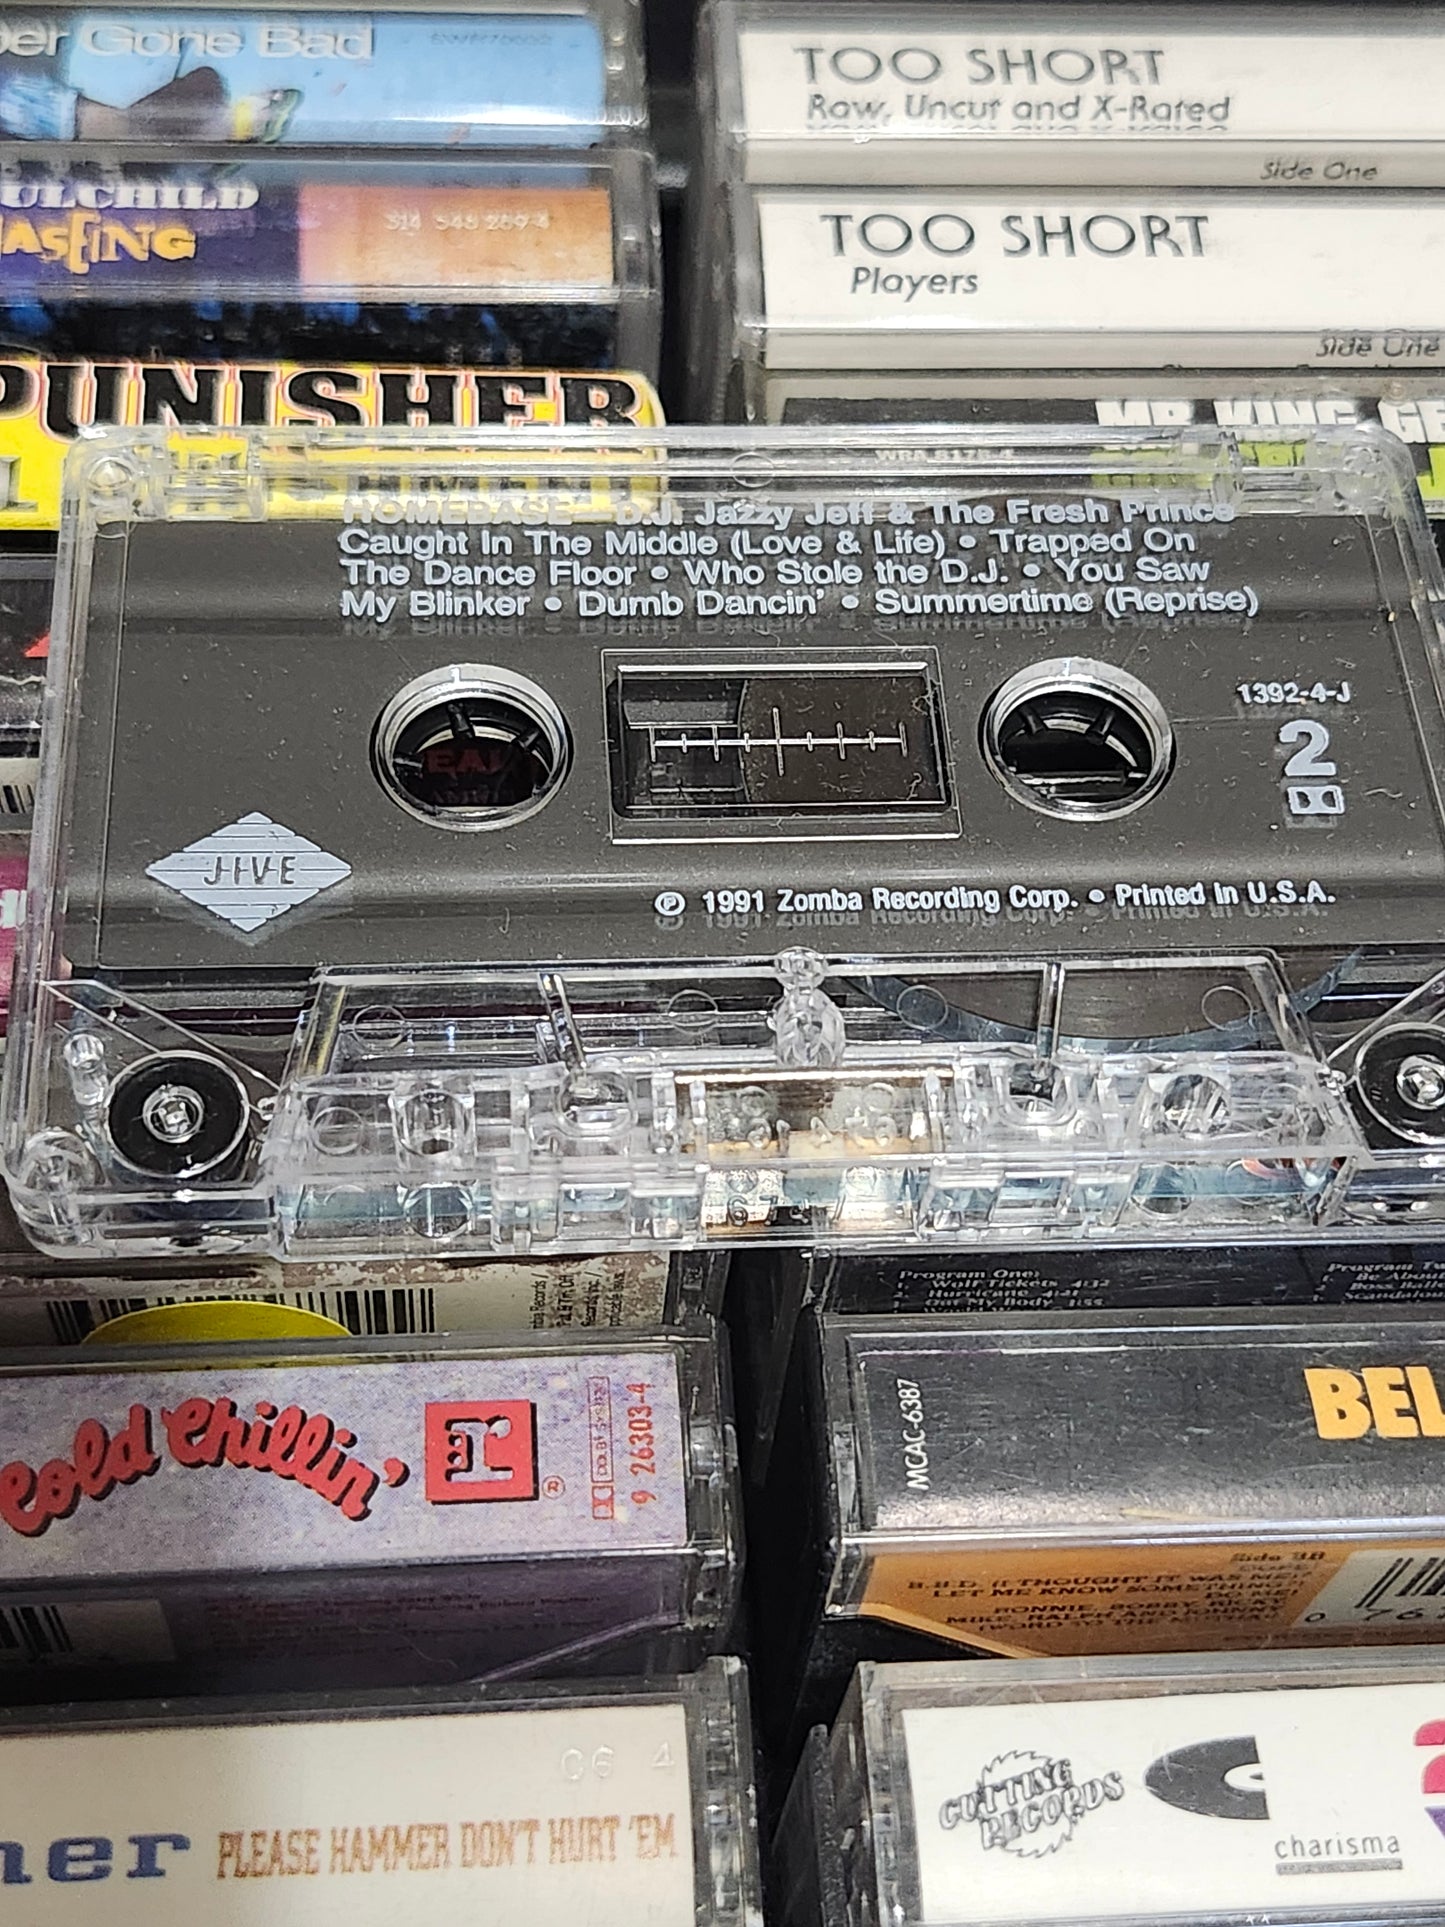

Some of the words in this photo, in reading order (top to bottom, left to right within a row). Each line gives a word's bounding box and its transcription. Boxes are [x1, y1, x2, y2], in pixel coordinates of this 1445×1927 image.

[82, 22, 243, 58] Gone
[258, 19, 374, 60] Bad
[793, 47, 942, 85] TOO
[967, 47, 1164, 85] SHORT
[807, 94, 892, 123] Raw,
[904, 94, 1000, 122] Uncut
[1012, 94, 1081, 122] and
[1090, 95, 1231, 123] X-Rated
[1260, 161, 1314, 181] Side
[1323, 161, 1378, 181] One
[819, 213, 975, 258] TOO
[1000, 213, 1208, 258] SHORT
[850, 266, 978, 303] Players
[1316, 333, 1372, 358] Side
[1382, 333, 1441, 358] One
[695, 500, 793, 531] Jazzy
[805, 500, 874, 526] Jeff
[888, 501, 915, 525] &
[925, 500, 995, 525] The
[1007, 498, 1109, 524] Fresh
[1121, 498, 1236, 523] Prince
[338, 528, 468, 560] Caught
[482, 530, 512, 556] In
[524, 530, 592, 556] The
[605, 529, 718, 556] Middle
[731, 529, 823, 560] (Love
[836, 530, 862, 555] &
[874, 529, 945, 560] Life)
[989, 528, 1132, 559] Trapped
[1144, 527, 1195, 552] On
[340, 559, 410, 586] The
[424, 559, 536, 586] Dance
[550, 560, 637, 586] Floor
[683, 560, 765, 585] Who
[777, 559, 863, 585] Stole
[874, 559, 928, 584] the
[941, 558, 1008, 584] D.J.
[1055, 557, 1124, 583] You
[1136, 556, 1210, 582] Saw
[340, 590, 396, 622] My
[410, 590, 530, 617] Blinker
[579, 590, 684, 617] Dumb
[697, 589, 825, 616] Dancin'
[874, 588, 1093, 614] Summertime
[1105, 585, 1259, 619] (Reprise)
[1237, 682, 1350, 703] 1392-4-J
[1279, 719, 1337, 776] 2
[203, 855, 297, 886] JIVE
[702, 889, 764, 914] 1991
[776, 888, 863, 912] Zomba
[872, 886, 1000, 914] Recording
[1009, 885, 1079, 913] Corp.
[1115, 881, 1206, 907] Printed
[1248, 879, 1336, 905] U.S.A.
[900, 1270, 986, 1280] Program
[932, 1279, 983, 1289] Wolf
[988, 1278, 1058, 1288] Tickets
[1327, 1263, 1414, 1272] Program
[928, 1289, 1030, 1298] Hurricane
[626, 1382, 657, 1475] 26303-4
[897, 1378, 930, 1491] MCAC-6387
[0, 1403, 162, 1537] Cold
[630, 1490, 656, 1505] 9
[933, 1588, 984, 1598] LET
[991, 1587, 1032, 1596] ME
[1039, 1586, 1119, 1596] KNOW
[1017, 1575, 1149, 1587] THOUGHT
[1156, 1575, 1181, 1583] IT
[939, 1757, 1073, 1831] CUTTING
[980, 1771, 1125, 1850] RECORDS
[217, 1829, 321, 1880] PLEASE
[329, 1823, 449, 1874] HAMMER
[461, 1818, 540, 1868] DON'T
[549, 1814, 621, 1865] HURT
[1274, 1831, 1401, 1859] charisma
